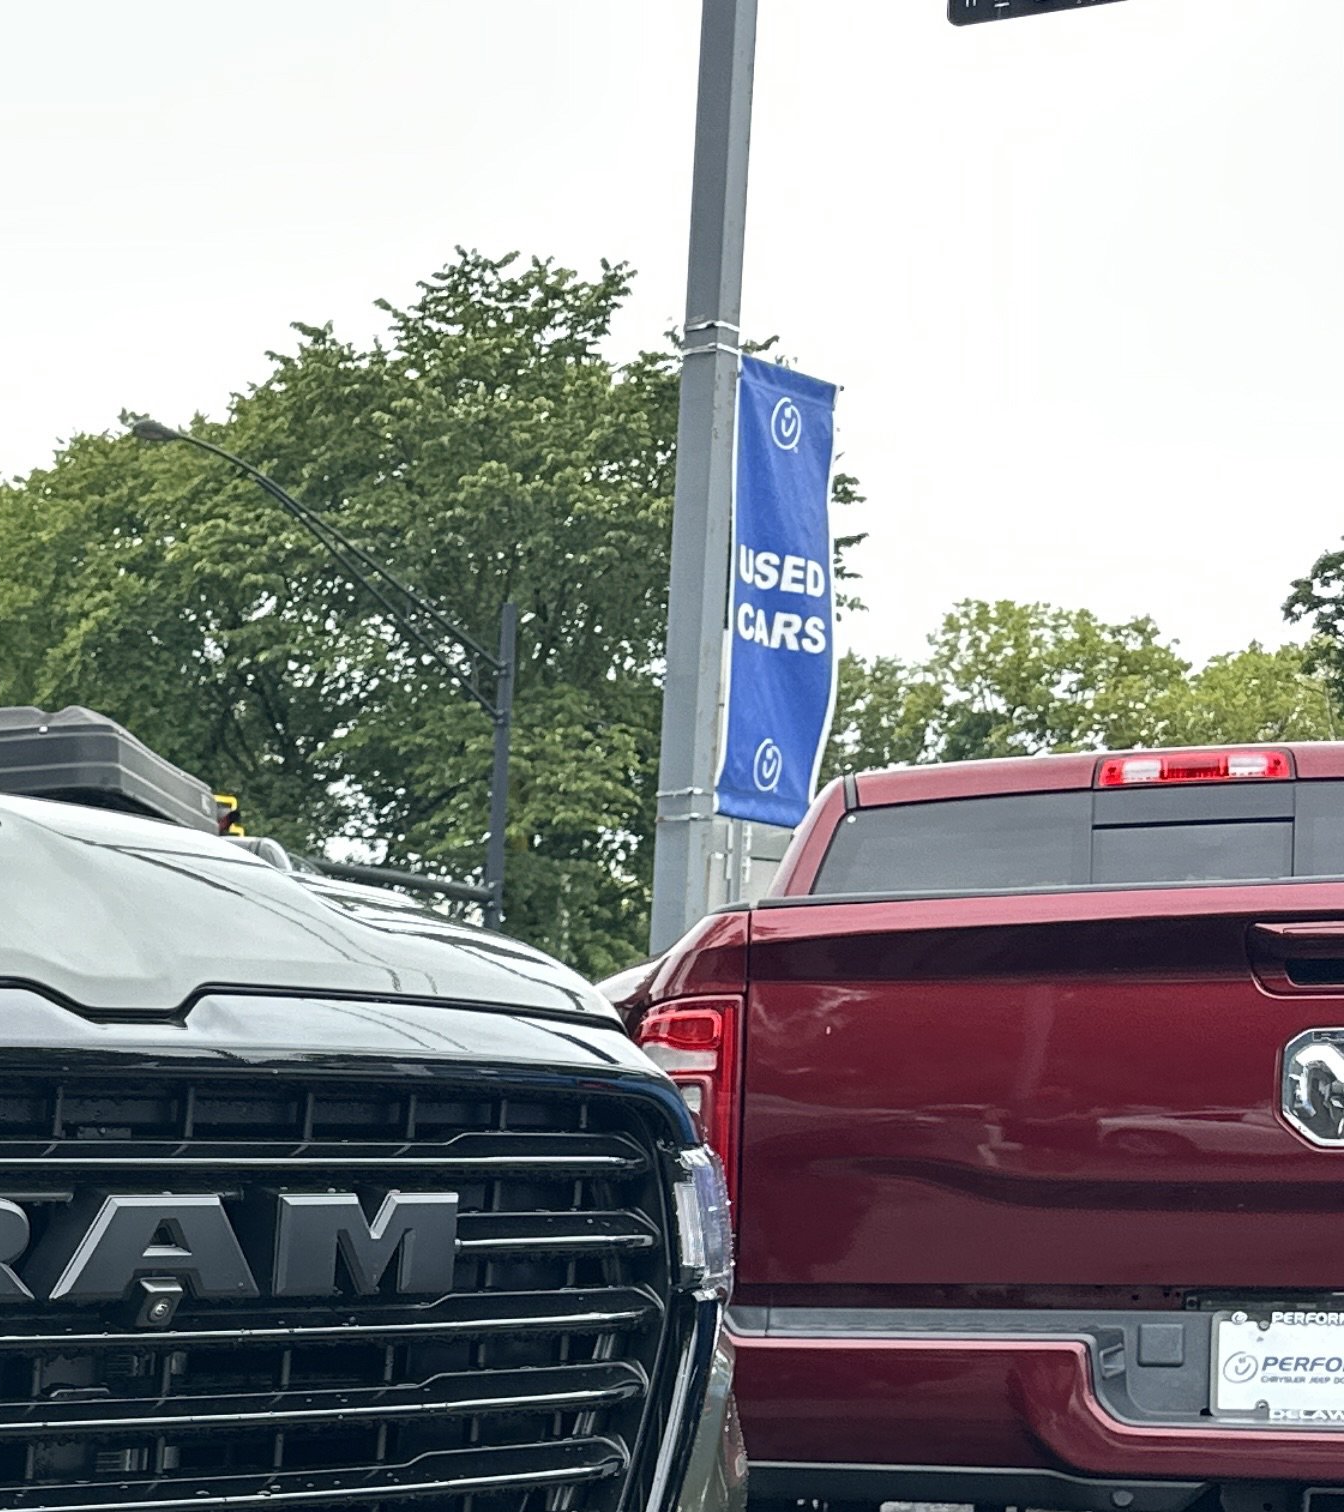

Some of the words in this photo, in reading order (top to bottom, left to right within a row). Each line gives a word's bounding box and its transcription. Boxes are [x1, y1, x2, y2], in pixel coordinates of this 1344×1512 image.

[739, 544, 825, 598] USED
[737, 602, 826, 653] CARS
[1261, 1356, 1344, 1373] PERFO
